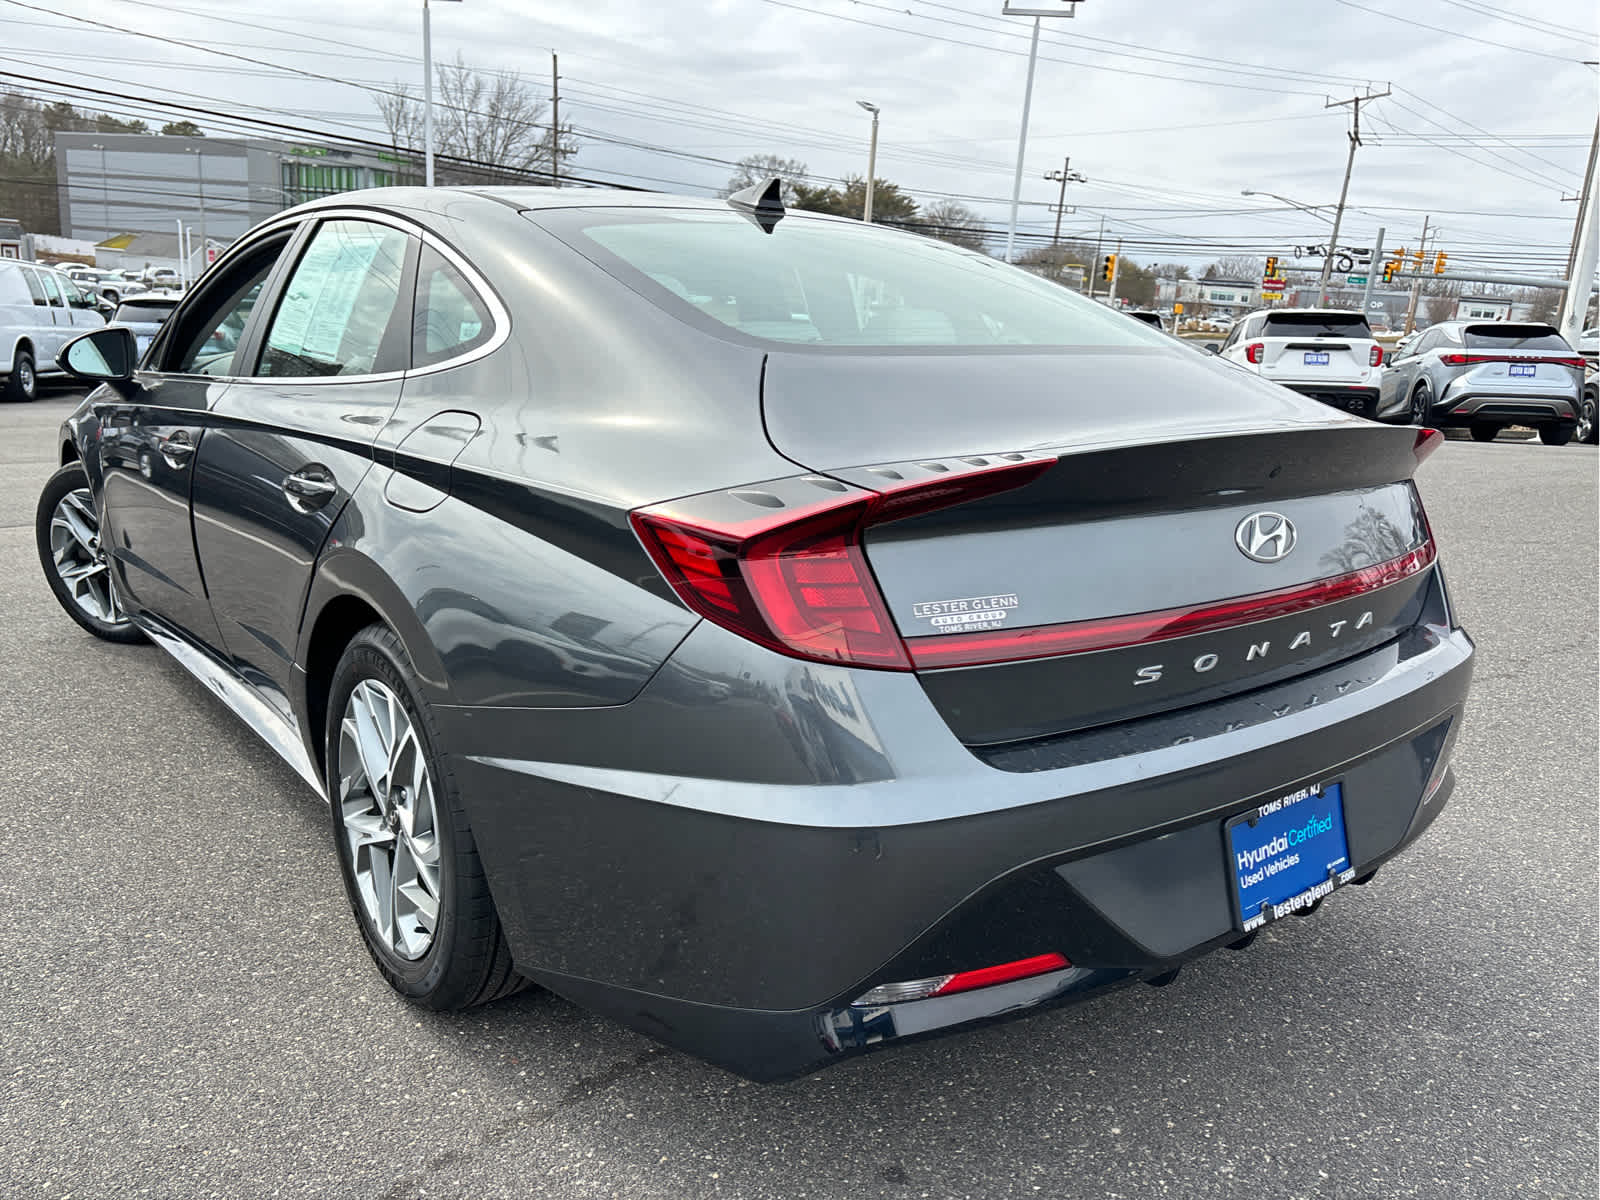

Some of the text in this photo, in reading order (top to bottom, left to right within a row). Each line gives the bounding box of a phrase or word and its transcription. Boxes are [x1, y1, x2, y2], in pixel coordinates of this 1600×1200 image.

[913, 597, 1018, 616] LESTER GLENN
[934, 612, 1004, 625] AUTO GROUP
[939, 624, 963, 633] TOMS
[992, 620, 1002, 628] NJ
[1133, 611, 1374, 687] SONATA
[1258, 799, 1282, 818] TOMS
[1310, 783, 1321, 797] NJ
[1236, 813, 1333, 870] Hyundai Certified
[1240, 853, 1300, 889] Used Vehicles
[1273, 880, 1334, 920] lesterglenn
